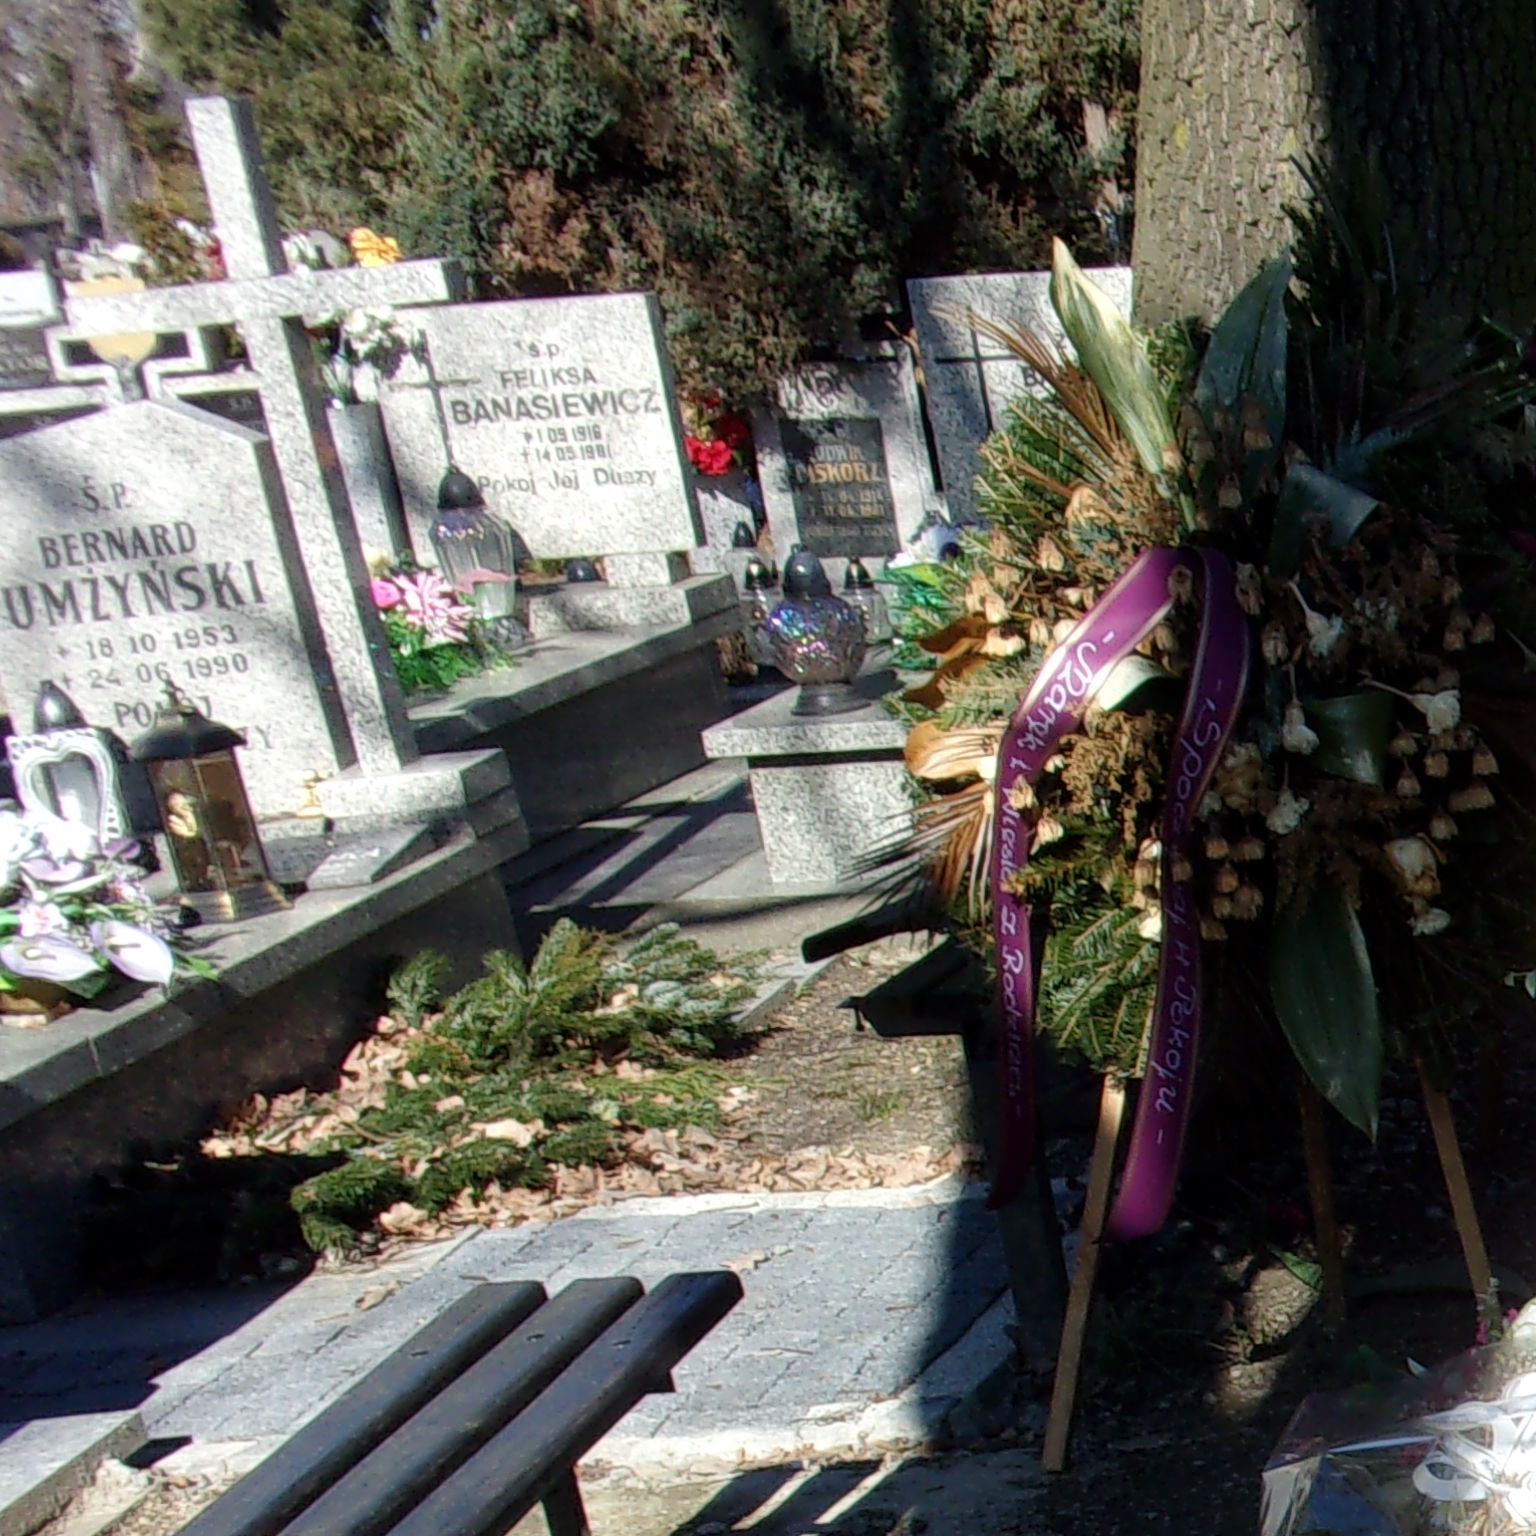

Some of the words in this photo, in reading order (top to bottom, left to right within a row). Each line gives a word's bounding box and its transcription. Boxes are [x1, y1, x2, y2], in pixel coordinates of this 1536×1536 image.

[499, 367, 598, 391] FELIKSA
[449, 387, 662, 426] BANASIEWICZ
[37, 520, 198, 570] BERNARD
[86, 636, 114, 661] 18
[129, 632, 157, 654] 10
[172, 623, 239, 651] 1953
[87, 668, 123, 690] 24
[182, 651, 249, 680] 1990
